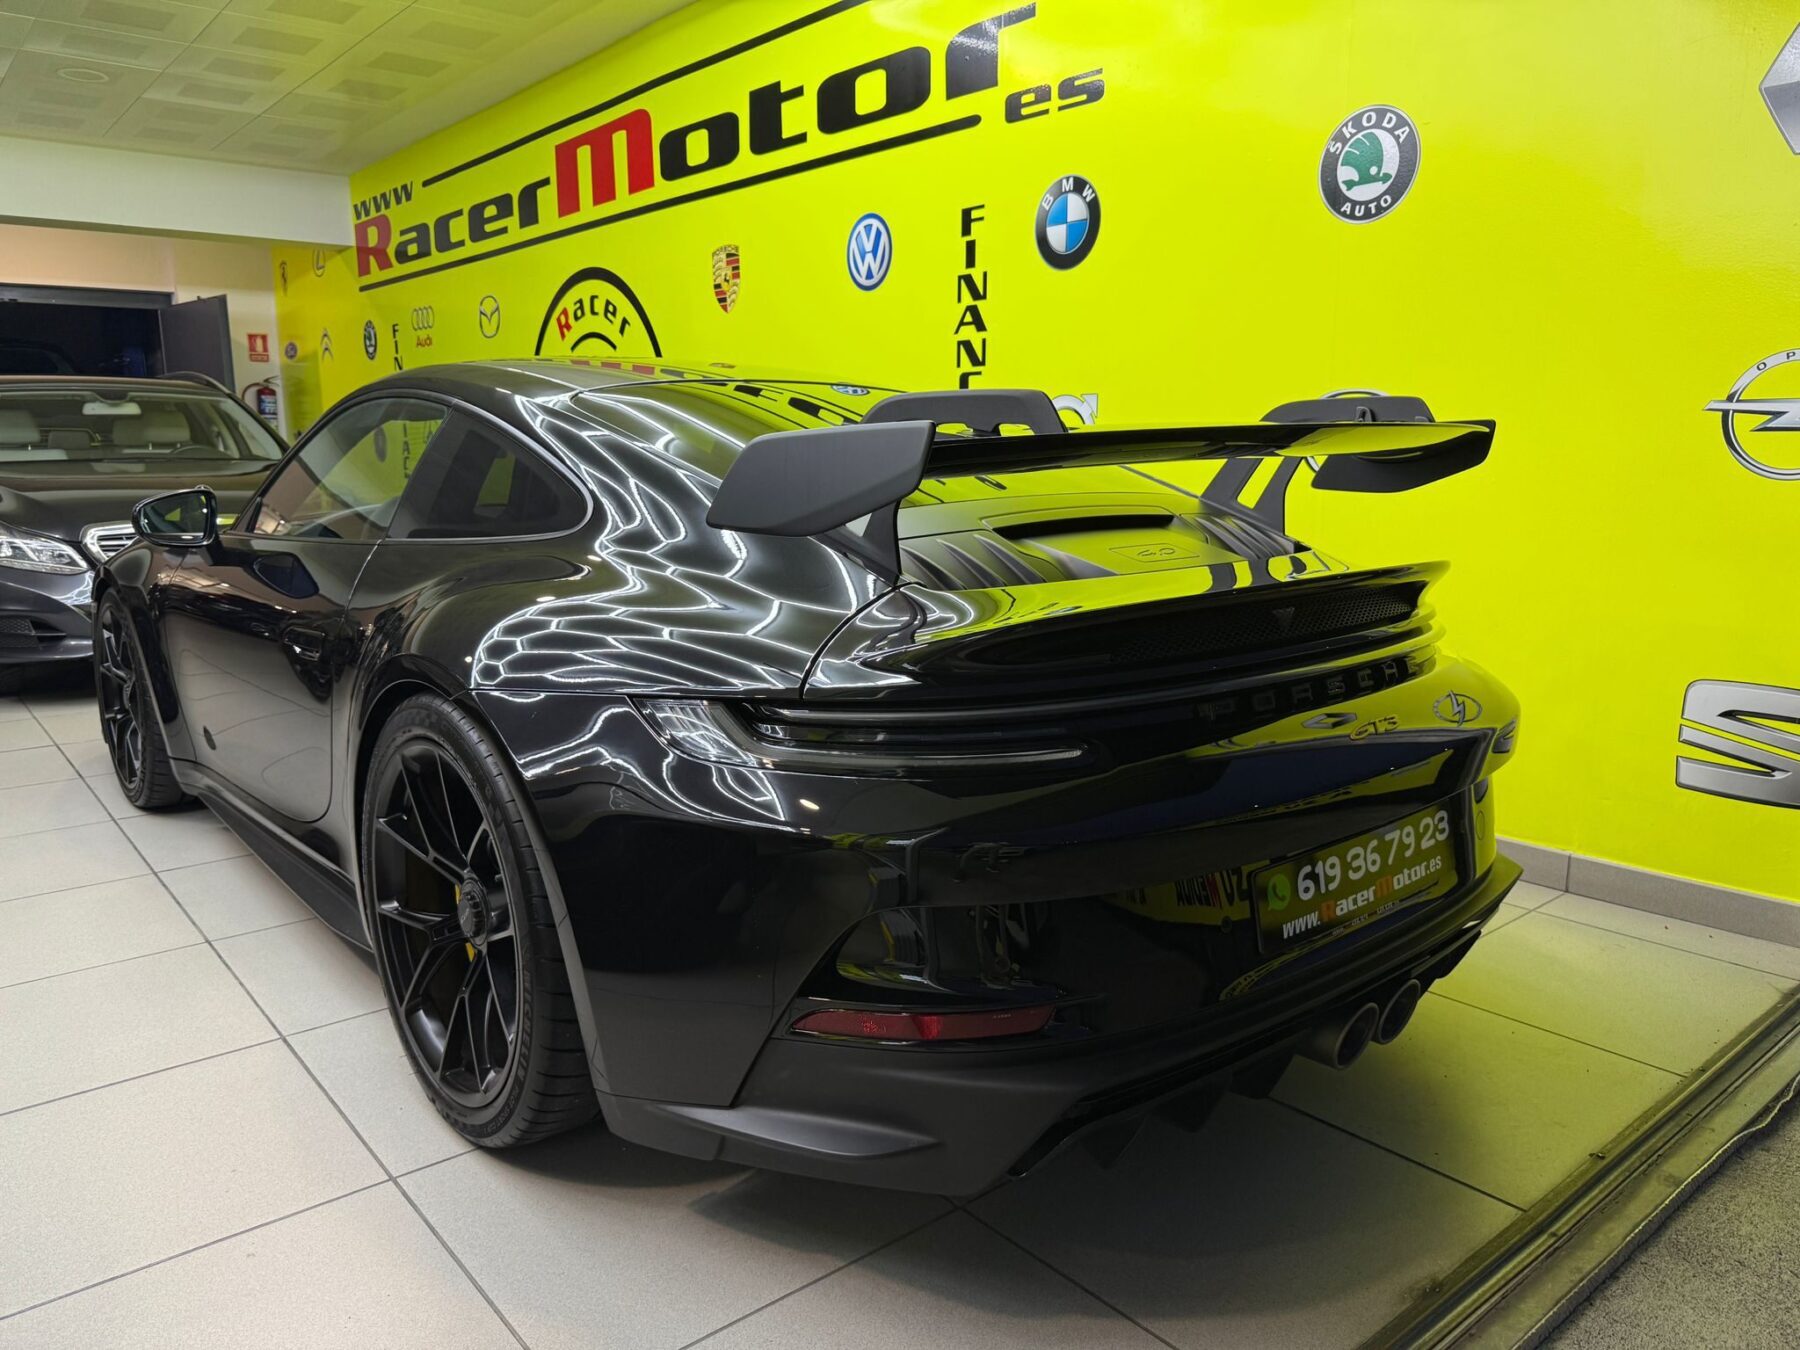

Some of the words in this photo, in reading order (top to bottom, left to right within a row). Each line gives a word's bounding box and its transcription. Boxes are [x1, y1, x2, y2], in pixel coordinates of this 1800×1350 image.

[353, 180, 413, 221] www
[1041, 176, 1095, 211] BMW
[1340, 194, 1392, 217] AUTO
[556, 295, 631, 341] Racer
[416, 335, 433, 348] Audi
[1350, 715, 1398, 741] GT3
[1297, 855, 1342, 901] 619
[1346, 839, 1381, 881] 36
[1385, 825, 1415, 866] 79
[1419, 810, 1450, 850] 23
